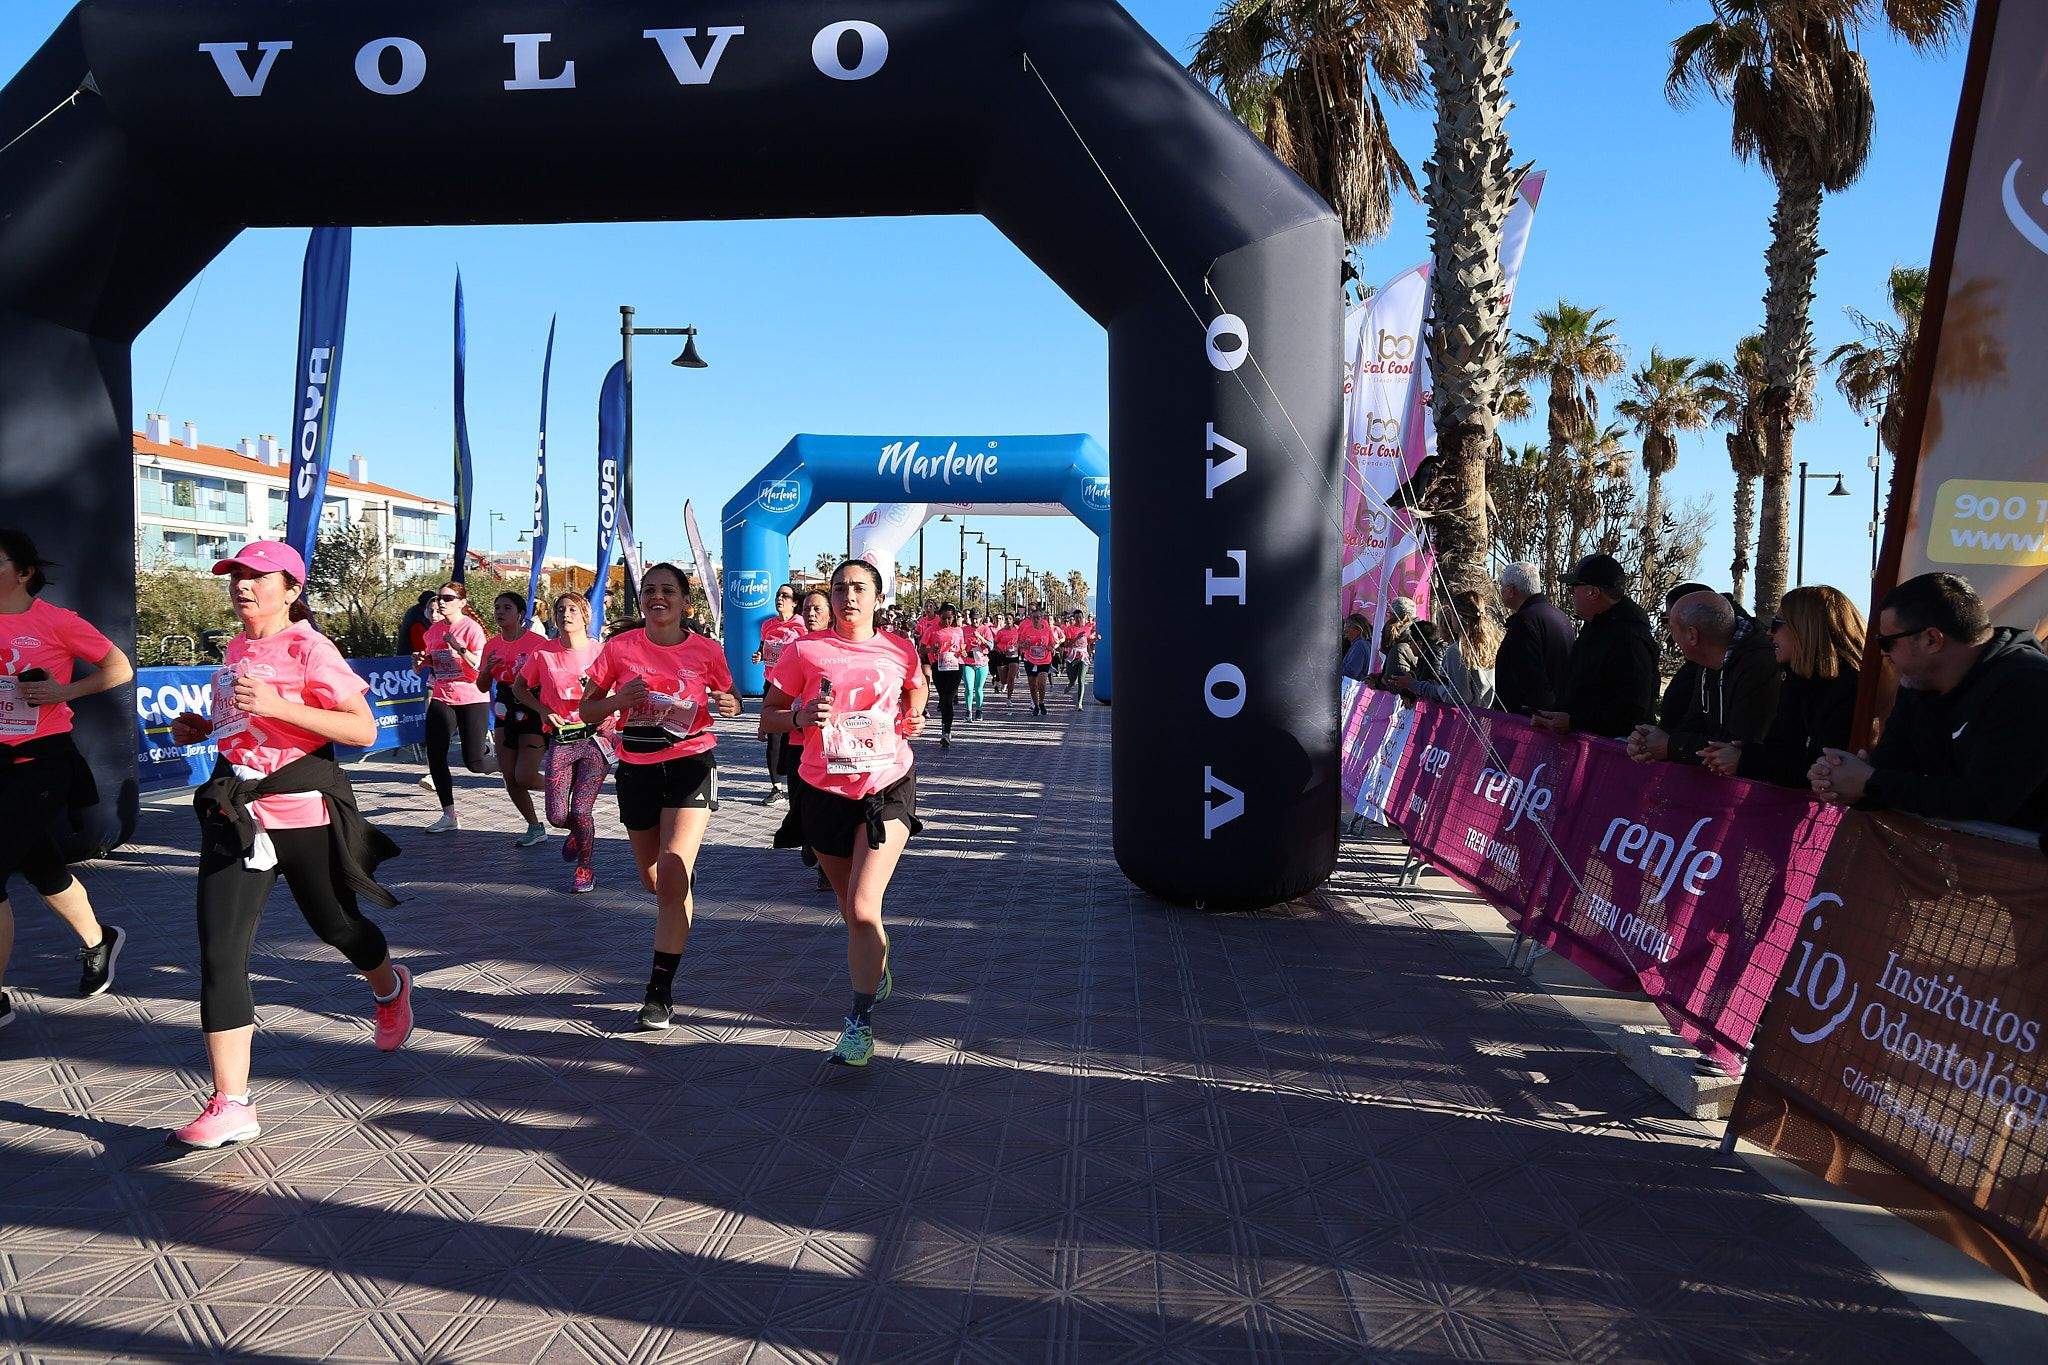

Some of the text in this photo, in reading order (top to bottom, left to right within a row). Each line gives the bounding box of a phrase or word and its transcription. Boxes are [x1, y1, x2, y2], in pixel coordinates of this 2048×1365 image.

[199, 20, 890, 97] VOLVO
[297, 347, 330, 499] GOYA
[1953, 494, 2028, 522] 900
[1203, 313, 1249, 839] VOLVO
[369, 669, 421, 699] GOYA
[149, 747, 181, 761] GOYA
[1473, 763, 1552, 832] renfe
[1464, 827, 1519, 874] TREN OFICIAL
[1599, 817, 1723, 904] renfe
[1586, 893, 1674, 963] TREN OFICIAL
[1876, 951, 2041, 1053] Institutos
[1842, 1066, 1974, 1158] Clínica dental
